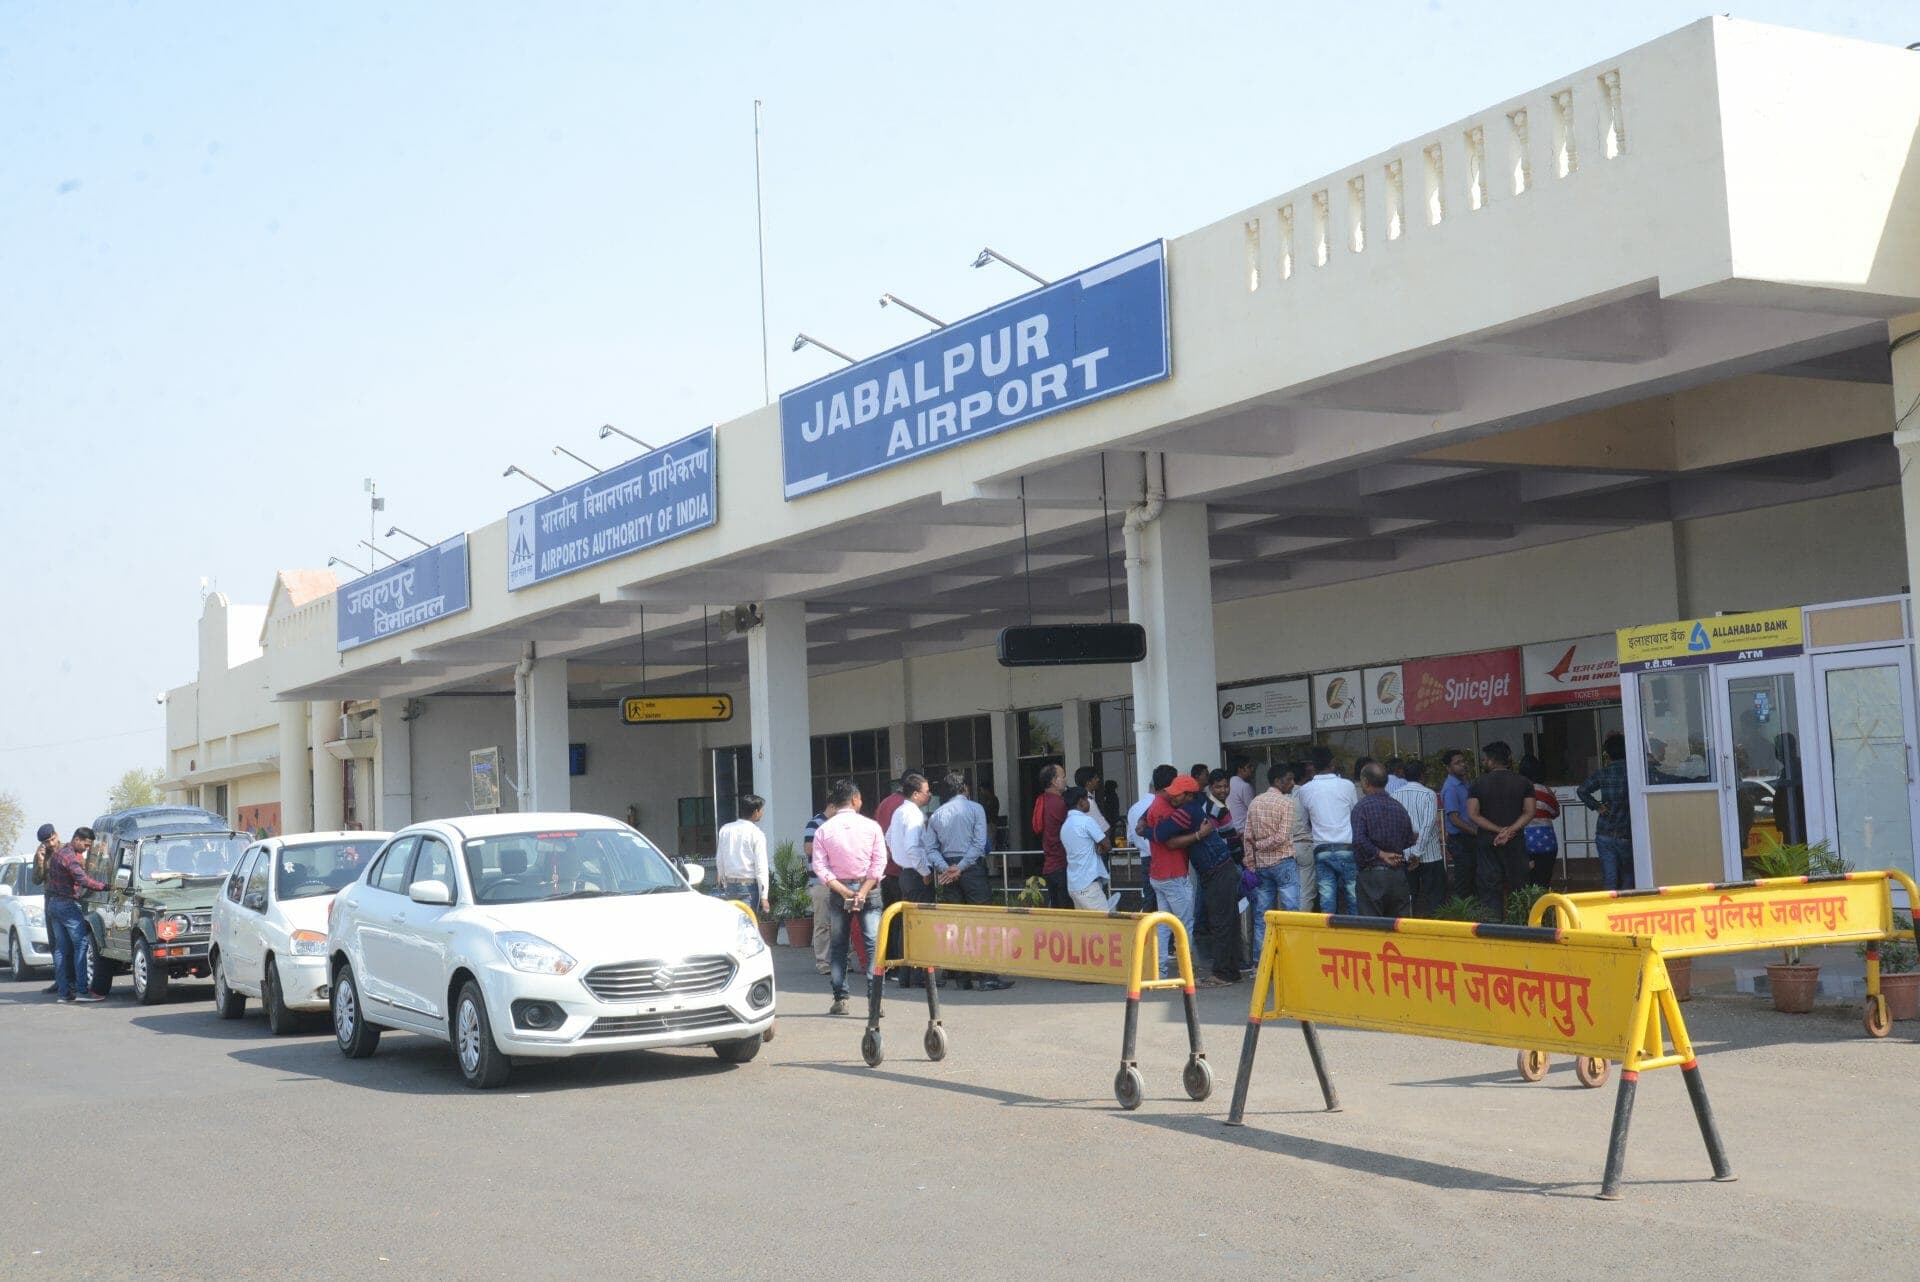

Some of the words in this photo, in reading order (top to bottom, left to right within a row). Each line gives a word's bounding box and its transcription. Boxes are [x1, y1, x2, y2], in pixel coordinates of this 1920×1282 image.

[801, 313, 1049, 443] JABALPUR
[886, 347, 1109, 457] AIRPORT
[541, 496, 578, 535] भारतीय
[583, 475, 643, 520] विमानपत्तन
[649, 448, 709, 495] प्राधिकरण
[541, 537, 590, 573] AIRPORTS
[592, 512, 654, 556] AUTHORITY
[657, 506, 673, 533] OF
[676, 493, 709, 527] INDIA
[347, 568, 415, 614] जबलपुर
[373, 595, 445, 635] विमानतल
[1712, 622, 1762, 637] ALLAHABAD
[1764, 620, 1788, 632] BANK
[1628, 633, 1668, 649] इलाहाबाद
[1738, 650, 1763, 660] ATM
[1444, 673, 1511, 709] SpiceJet
[1571, 674, 1590, 682] AIR
[1607, 908, 1696, 936] यातायात
[1701, 895, 1764, 940] पुलिस
[1769, 896, 1848, 931] जबलपुर
[932, 923, 1023, 960] TRAFFIC
[1033, 928, 1123, 968] POLICE
[1318, 947, 1375, 995] नगर
[1377, 941, 1458, 1006] निगम
[1461, 962, 1595, 1038] जबलपुर
